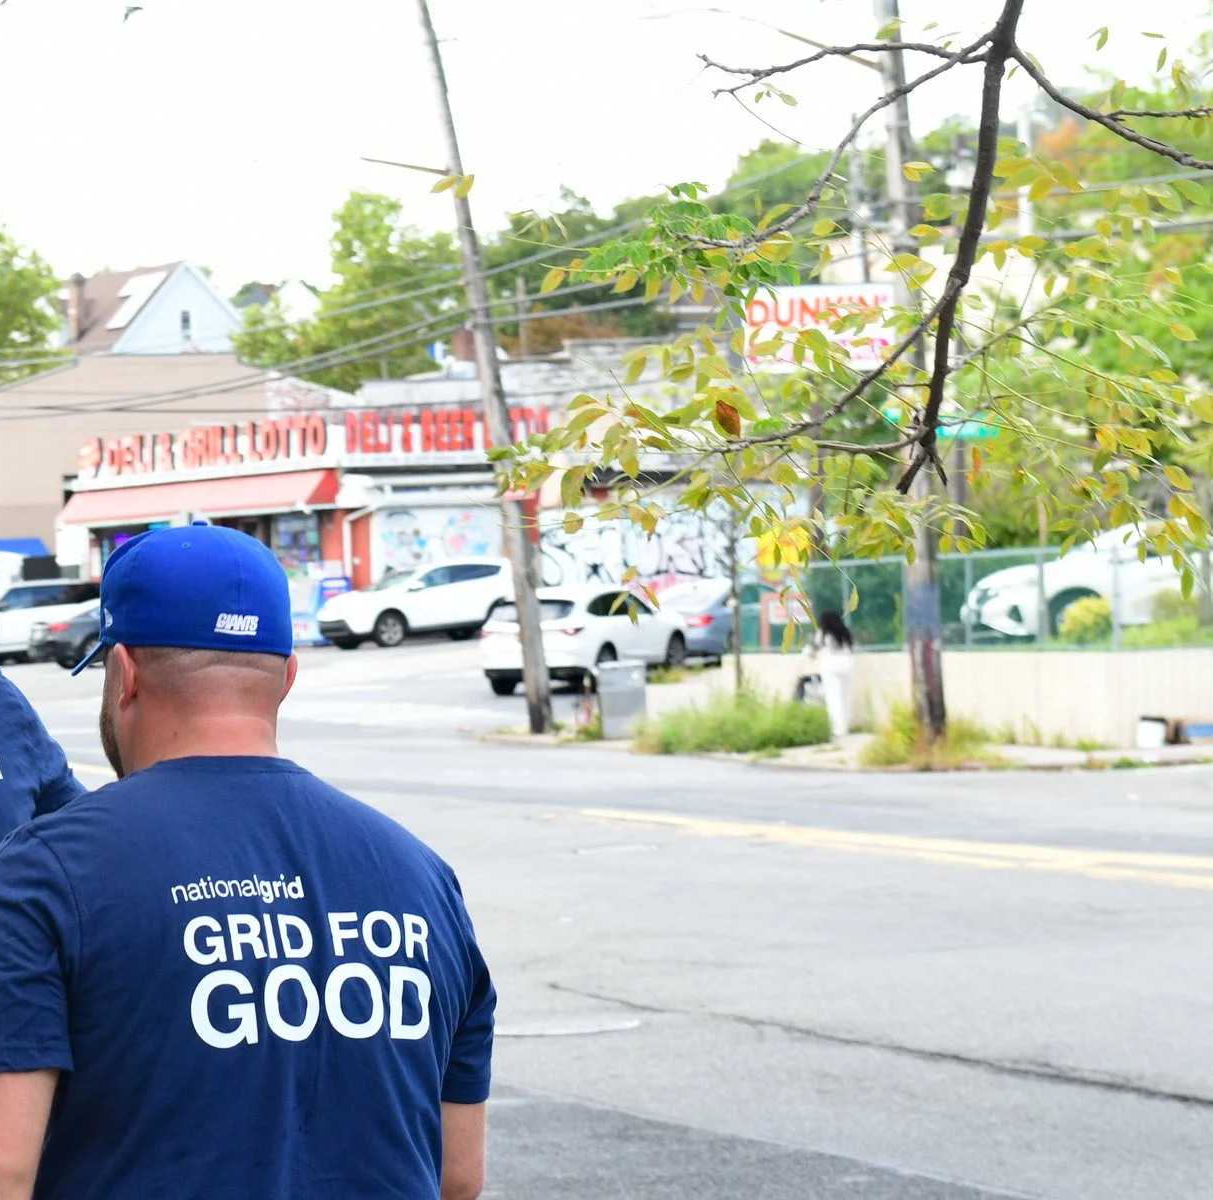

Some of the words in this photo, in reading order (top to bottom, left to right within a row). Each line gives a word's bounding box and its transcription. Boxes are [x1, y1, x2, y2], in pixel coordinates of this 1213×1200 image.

[105, 433, 155, 476] DELI
[178, 423, 244, 470] GRILL
[247, 411, 327, 463] LOTTO
[344, 411, 395, 454] DELI
[420, 407, 478, 451] BEER
[215, 612, 260, 632] GIANTS
[170, 873, 305, 904] nationalgrid
[183, 912, 314, 966] GRID
[327, 909, 430, 963] FOR
[190, 961, 432, 1049] GOOD
